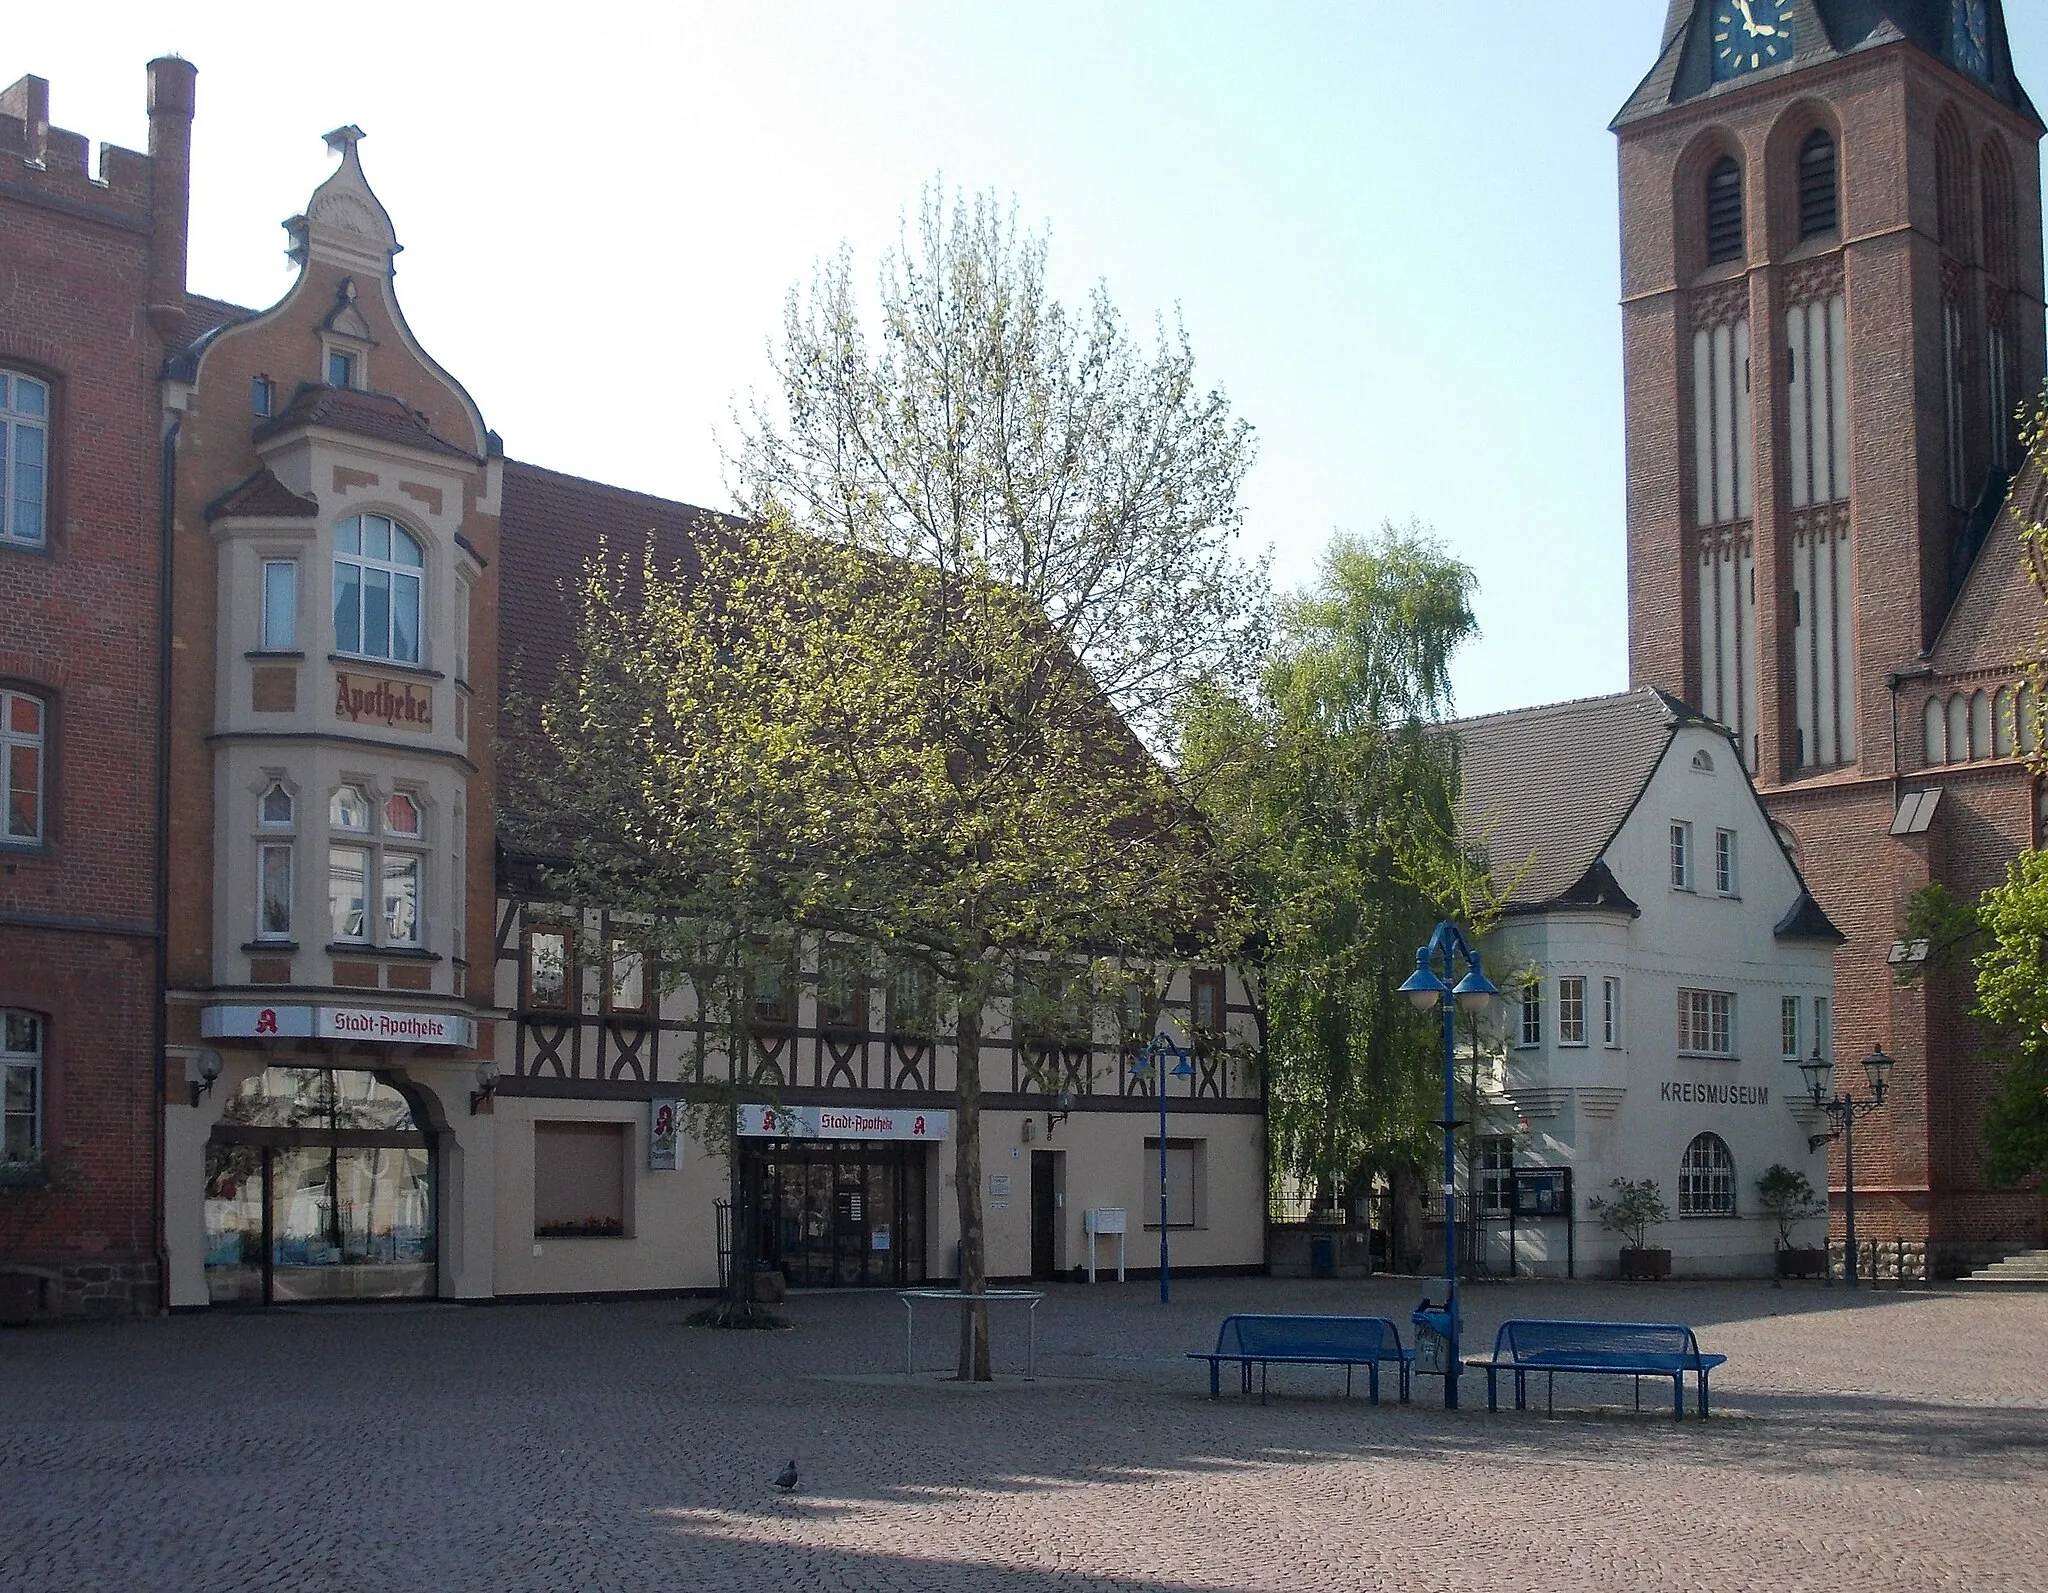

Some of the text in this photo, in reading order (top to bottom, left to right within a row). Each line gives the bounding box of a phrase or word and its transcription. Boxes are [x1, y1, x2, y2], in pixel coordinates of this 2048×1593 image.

[334, 1013, 444, 1038] Stadt-Apotheke
[1661, 1082, 1769, 1105] KREISMUSEUM
[821, 1113, 893, 1133] Stadt-Apotheke
